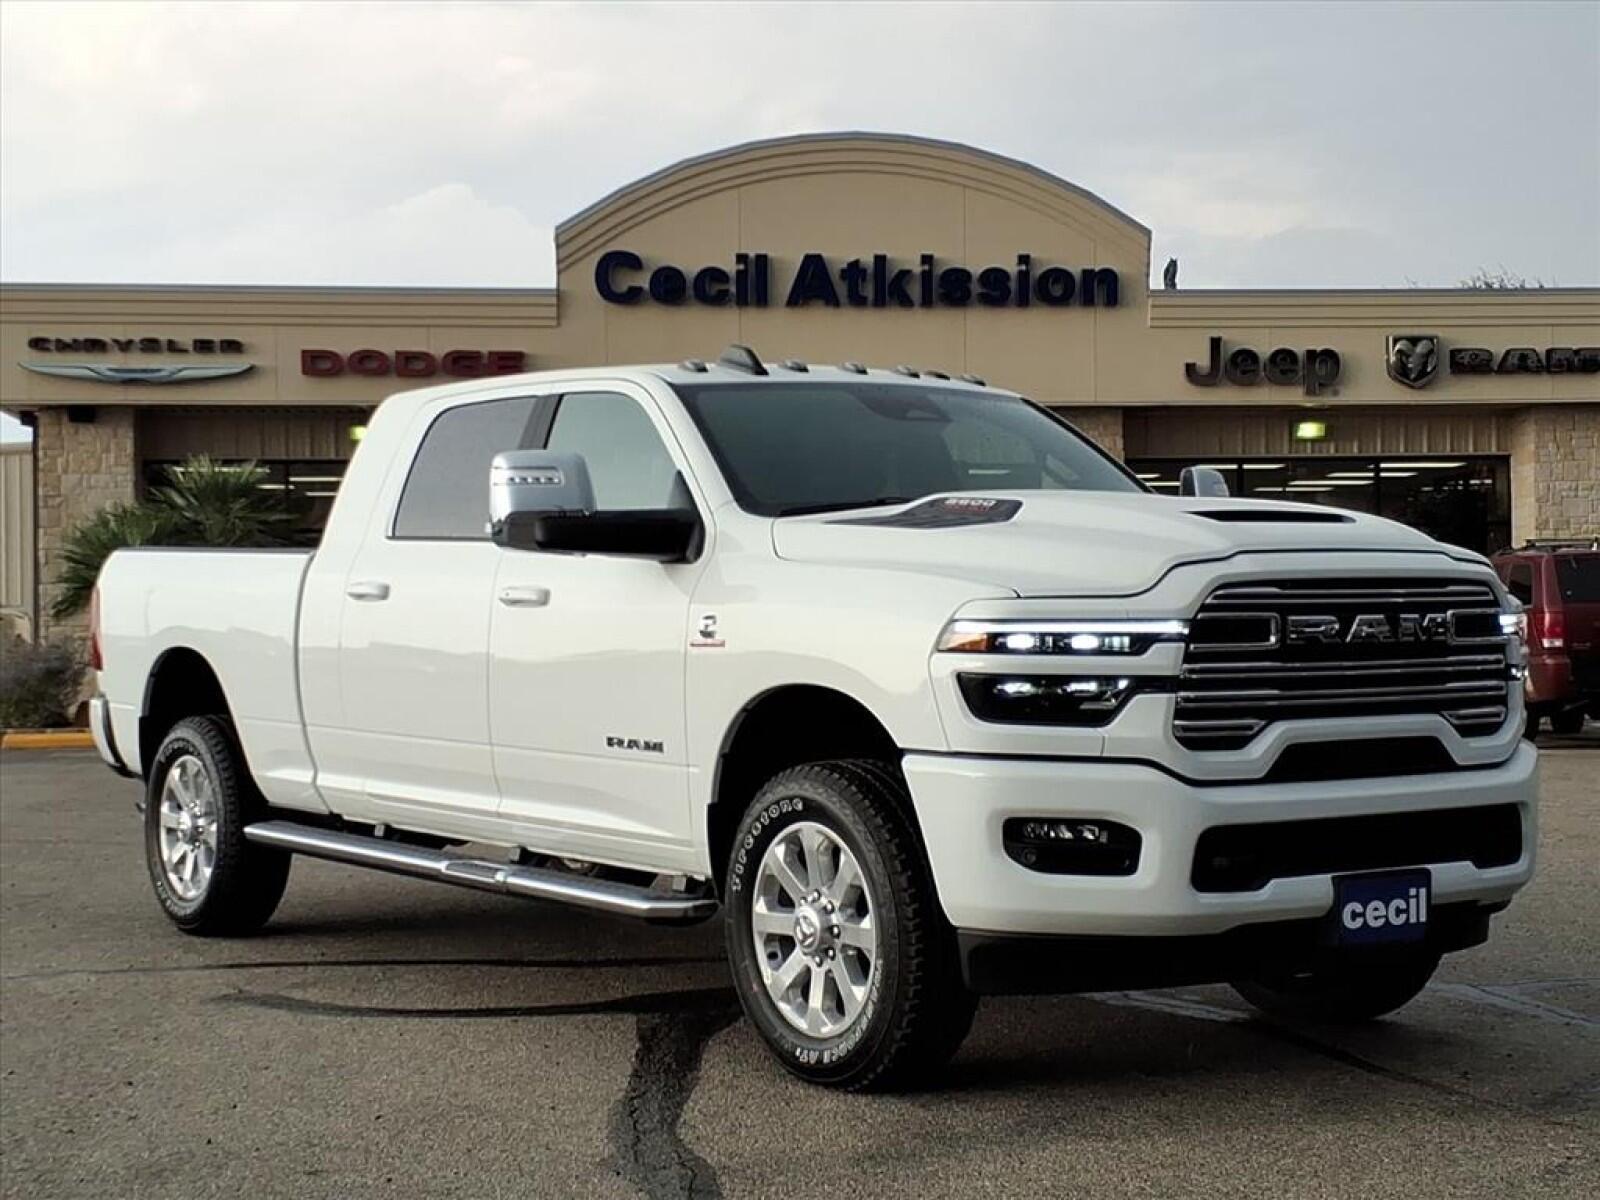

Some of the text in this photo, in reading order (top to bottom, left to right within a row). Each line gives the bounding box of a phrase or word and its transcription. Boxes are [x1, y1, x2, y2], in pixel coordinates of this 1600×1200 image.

[595, 250, 1120, 308] Cecil Atkission
[28, 336, 245, 354] CHRYSLER
[301, 348, 525, 378] DODGE
[1185, 336, 1341, 395] Jeep
[1450, 347, 1600, 375] RAM
[1287, 613, 1451, 643] RAM
[605, 736, 664, 754] RAM
[1342, 887, 1427, 929] cecil
